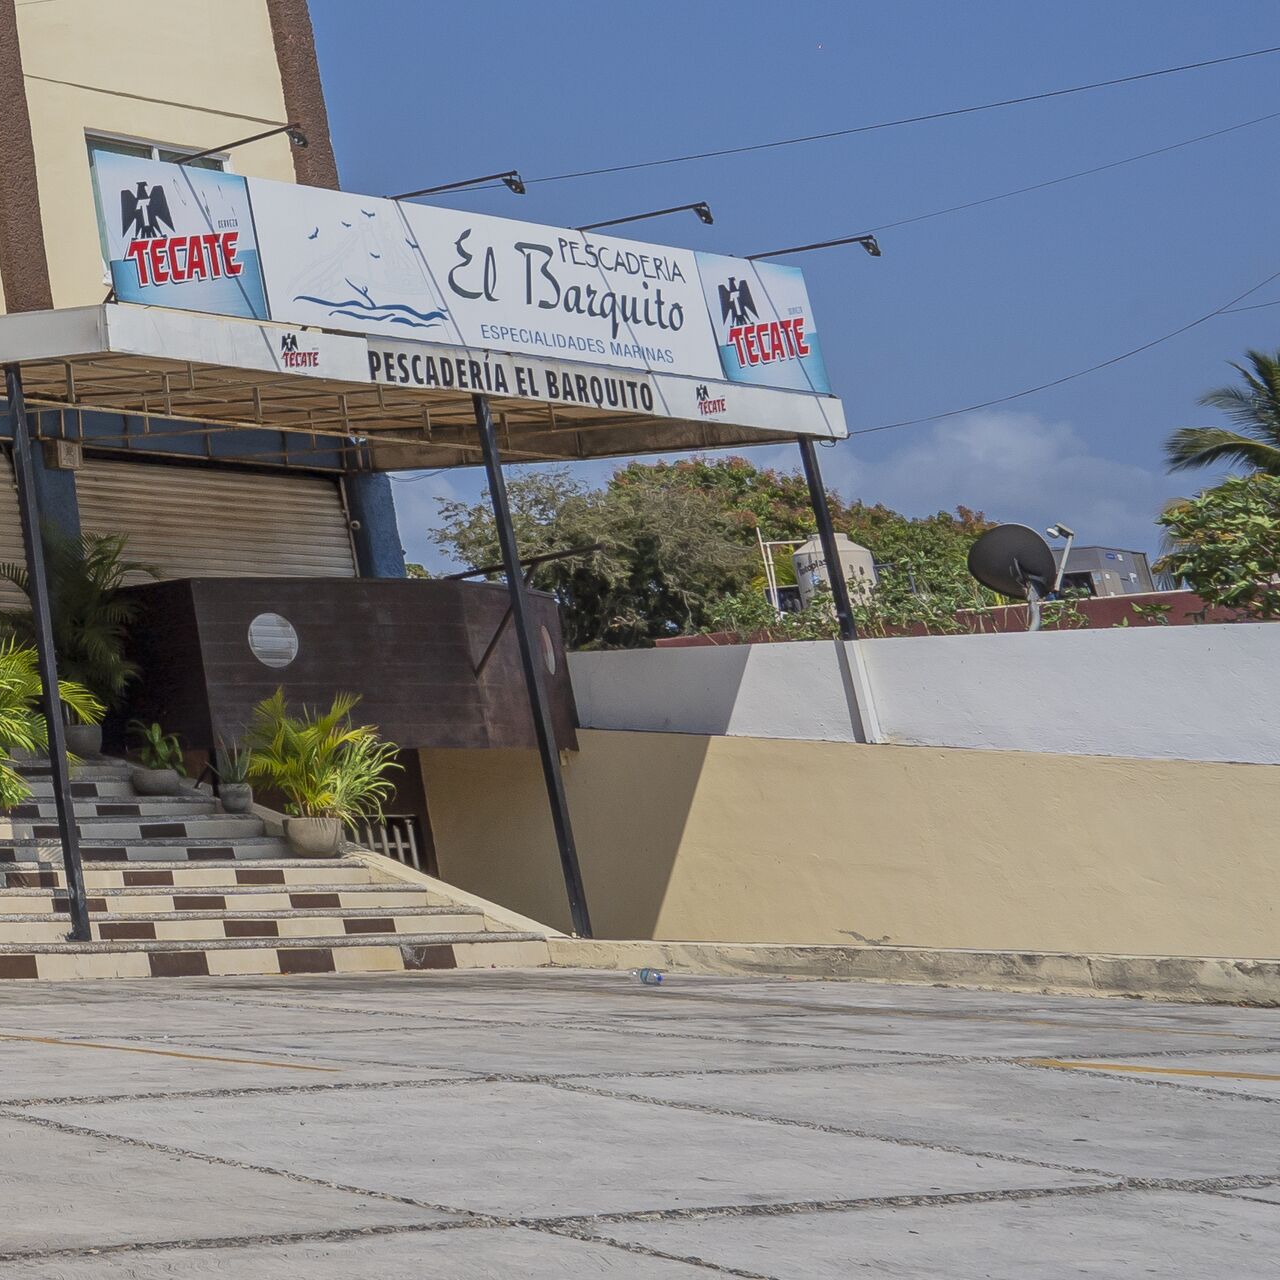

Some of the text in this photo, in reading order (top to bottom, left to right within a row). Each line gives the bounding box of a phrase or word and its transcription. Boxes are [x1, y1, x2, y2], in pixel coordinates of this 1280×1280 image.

[125, 232, 244, 287] TECATE
[448, 228, 684, 339] El Barquito
[282, 351, 319, 368] TECATE
[481, 324, 674, 363] ESPECIALIDADES MARINAS
[727, 317, 810, 367] TECATE
[368, 349, 653, 411] PESCADERÍA EL BARQUITO
[698, 398, 726, 416] TECATE
